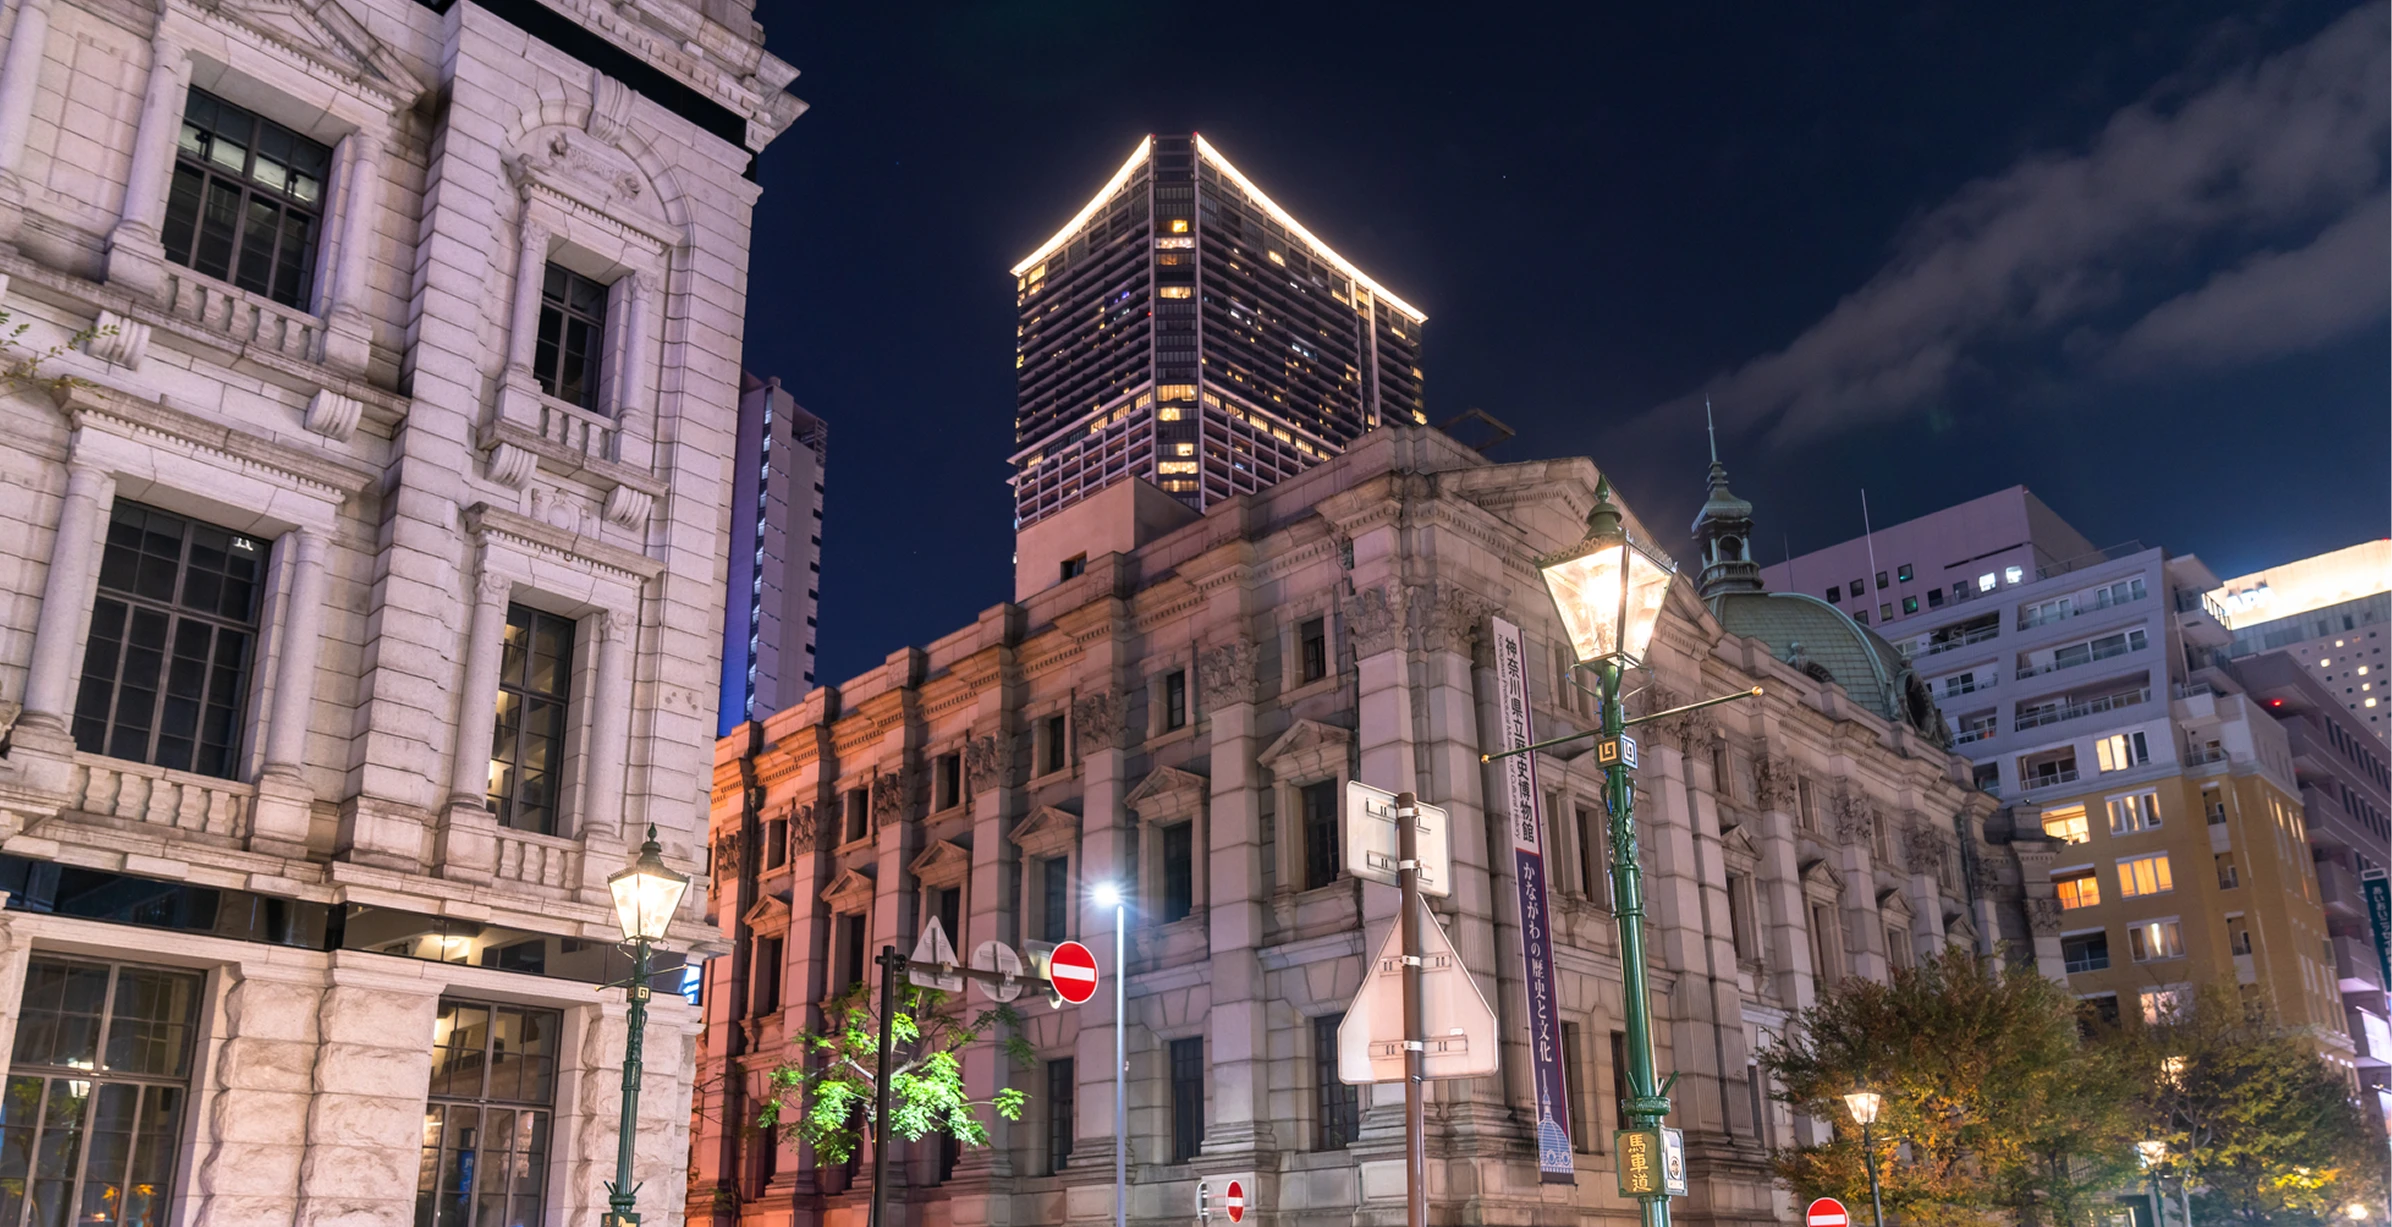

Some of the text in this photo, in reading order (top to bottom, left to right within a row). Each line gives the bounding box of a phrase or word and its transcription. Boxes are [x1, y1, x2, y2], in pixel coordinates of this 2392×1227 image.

[1505, 636, 1535, 845] 神奈川県立歴史博物館
[1506, 725, 1515, 763] Musem
[1522, 861, 1553, 1063] かながわの歴史と文化
[1627, 1133, 1652, 1192] 馬車道
